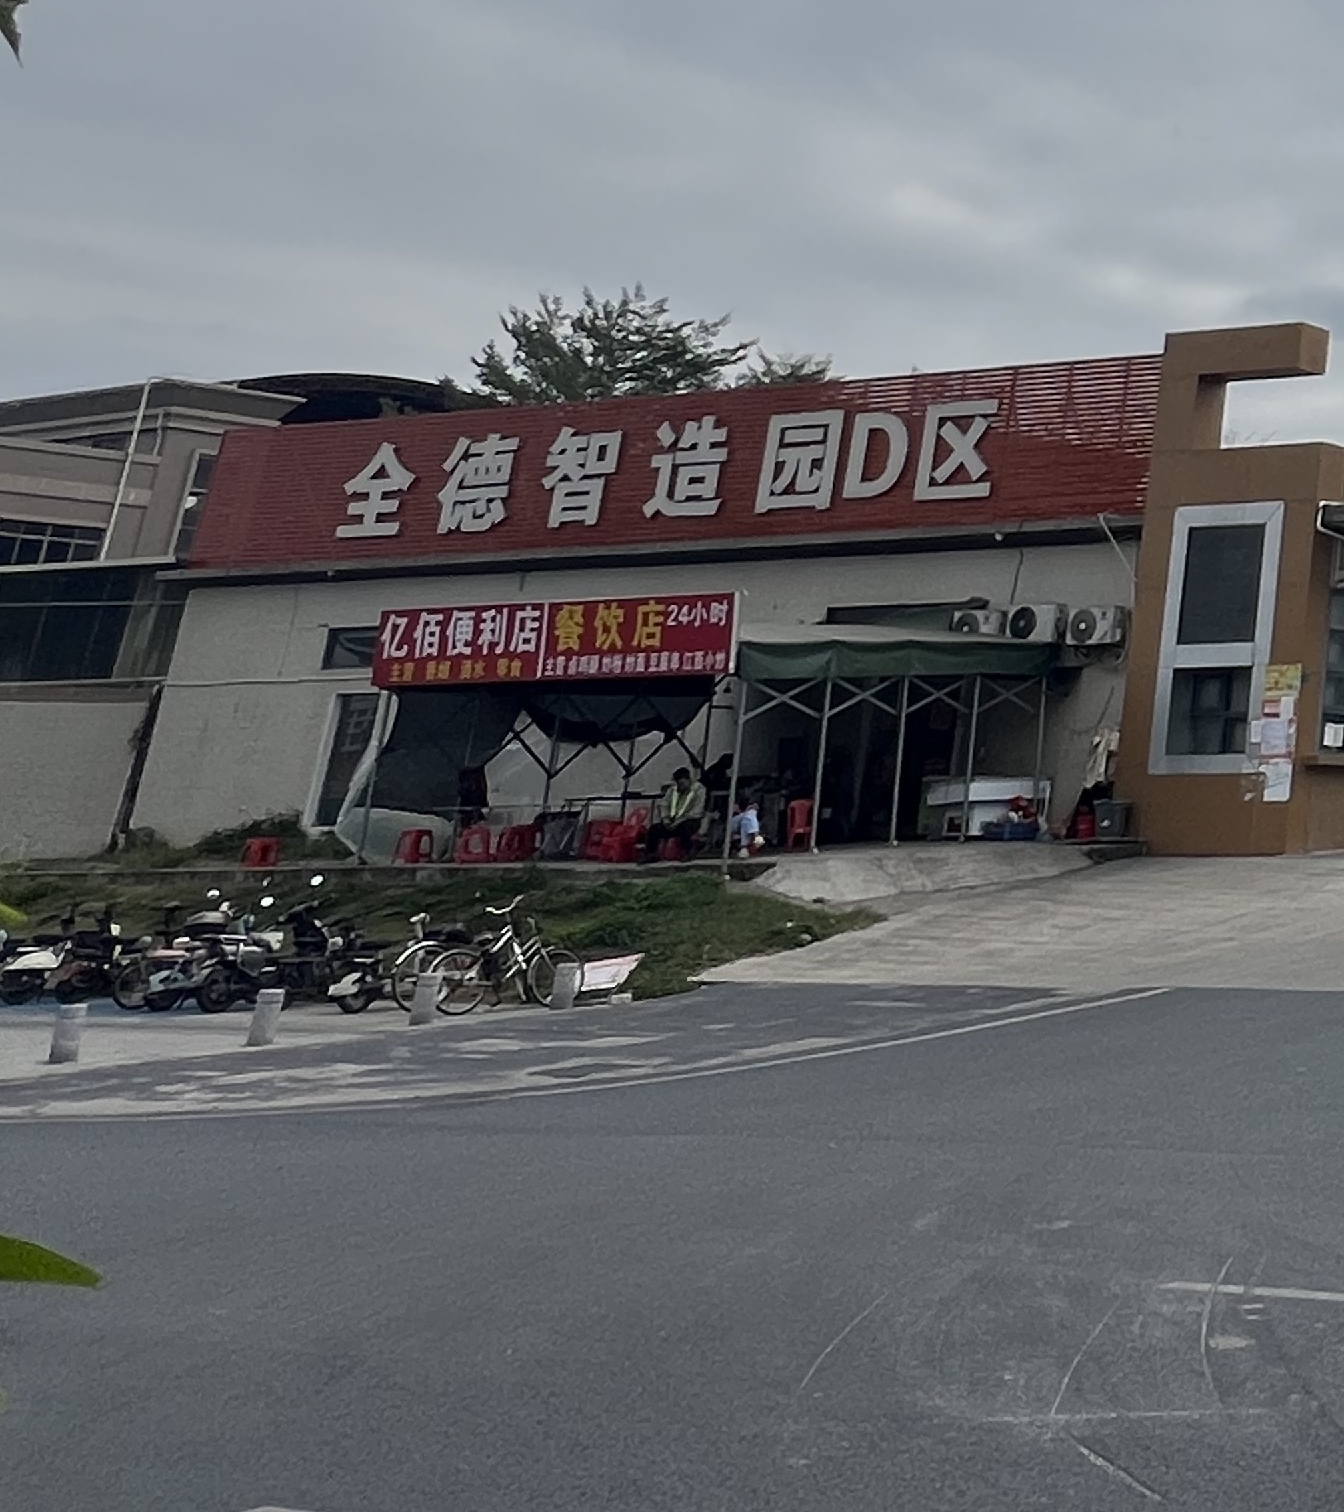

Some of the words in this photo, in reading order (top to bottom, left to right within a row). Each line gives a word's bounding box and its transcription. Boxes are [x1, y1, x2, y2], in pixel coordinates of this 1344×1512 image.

[335, 398, 999, 539] 全德智造园D区
[379, 605, 543, 660] 亿佰便利店
[553, 599, 666, 653] 餐饮店
[666, 598, 729, 628] 24小时
